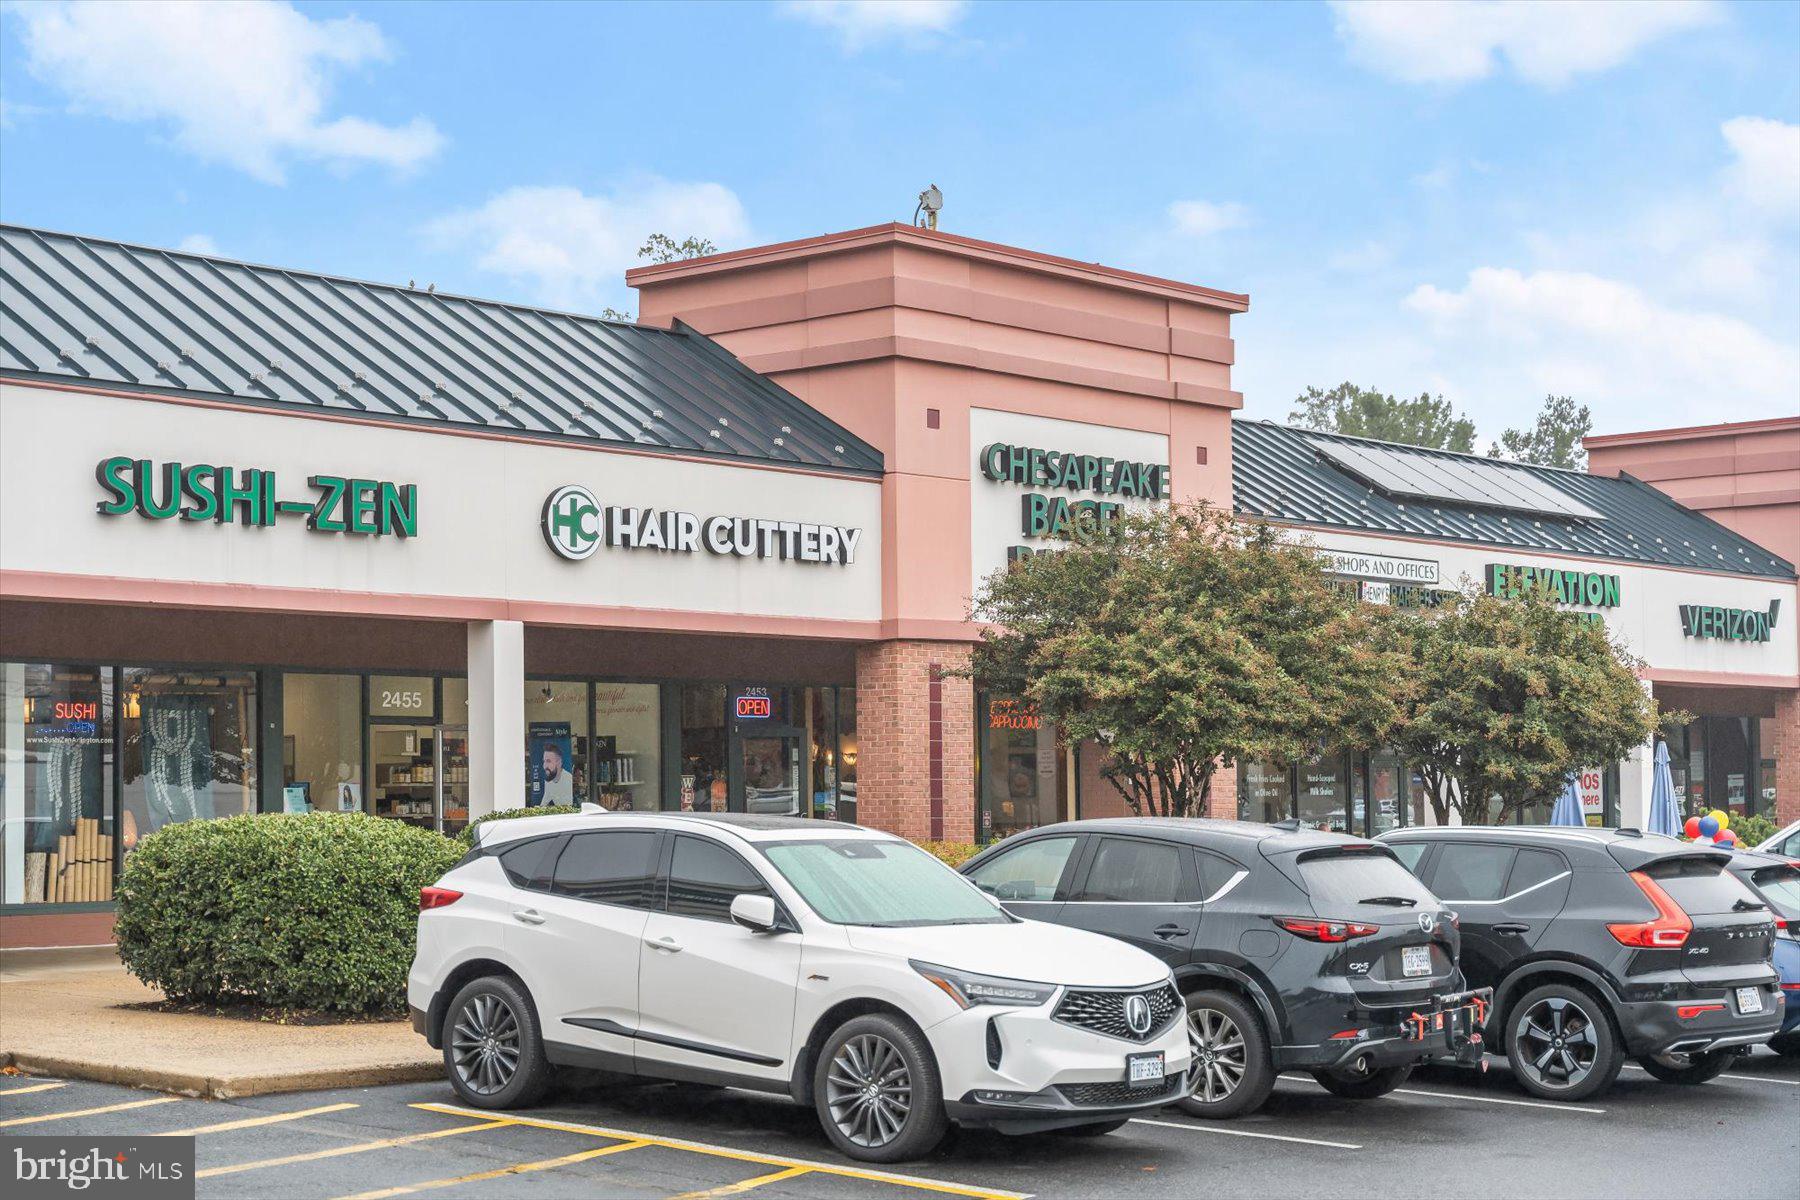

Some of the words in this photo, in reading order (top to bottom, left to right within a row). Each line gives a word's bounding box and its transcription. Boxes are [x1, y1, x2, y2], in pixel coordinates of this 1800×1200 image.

[980, 442, 1171, 500] CHESAPEAKE
[96, 456, 417, 538] SUSHI-ZEN
[605, 506, 700, 553] HAIR
[702, 515, 863, 565] CUTTERY
[1337, 556, 1370, 573] SHOPS
[1372, 560, 1394, 575] AND
[1397, 562, 1435, 580] OFFICES
[1485, 563, 1620, 607] ELEVATION
[1679, 604, 1771, 642] VERIZON
[382, 691, 422, 709] 2455
[745, 687, 767, 696] 2453
[55, 702, 97, 719] SUSHI
[738, 699, 769, 715] OPEN
[66, 722, 97, 733] OPEN
